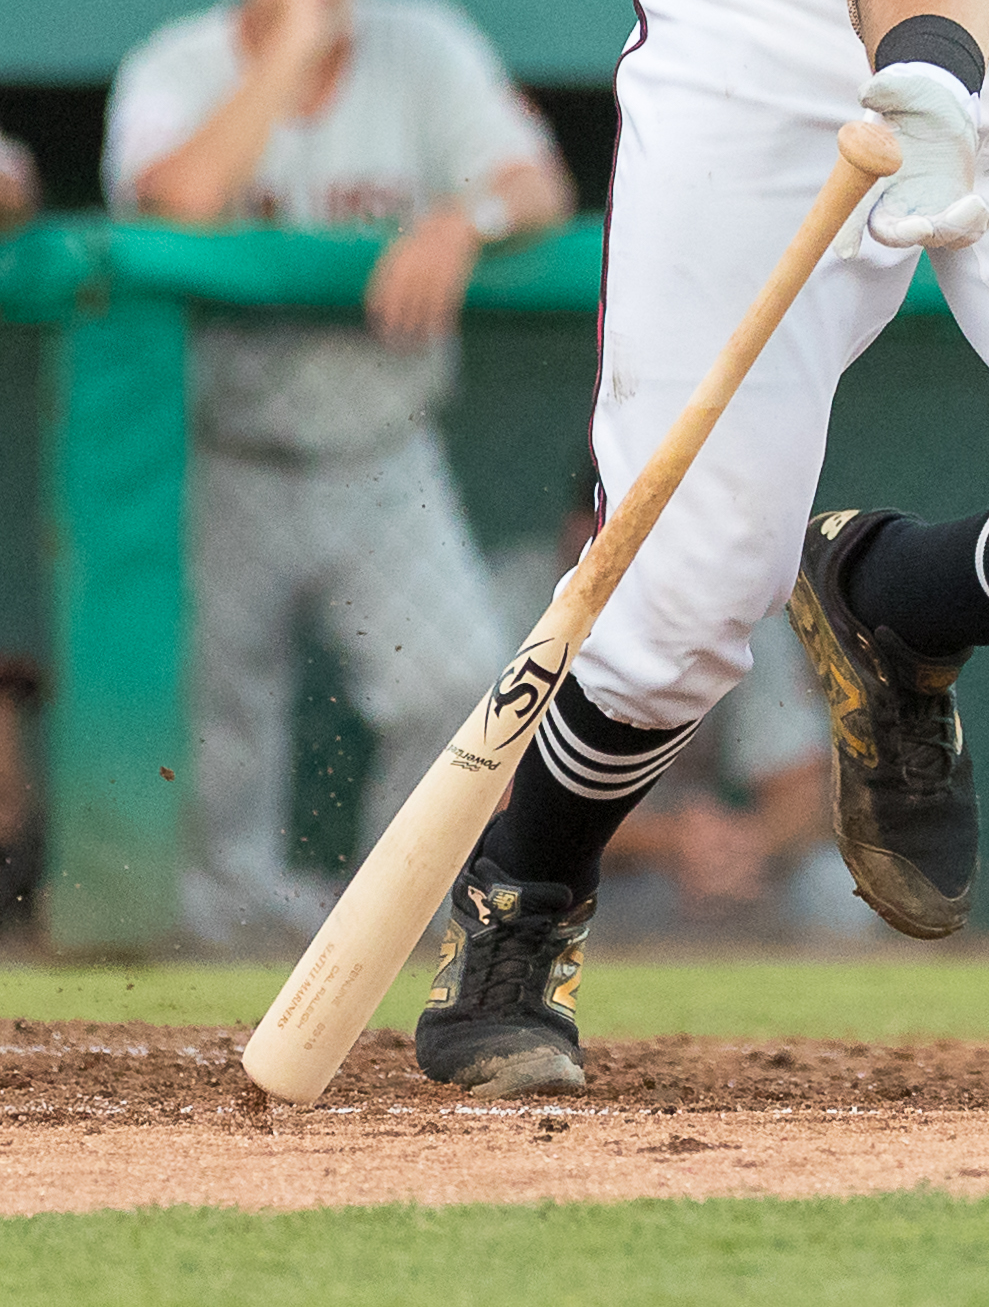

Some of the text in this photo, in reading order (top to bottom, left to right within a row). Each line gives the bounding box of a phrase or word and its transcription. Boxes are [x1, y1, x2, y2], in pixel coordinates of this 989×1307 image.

[277, 941, 336, 1031] SEATTLE MARINERS
[296, 965, 340, 1029] CAL RALEIGH
[330, 962, 364, 1007] GENUINE
